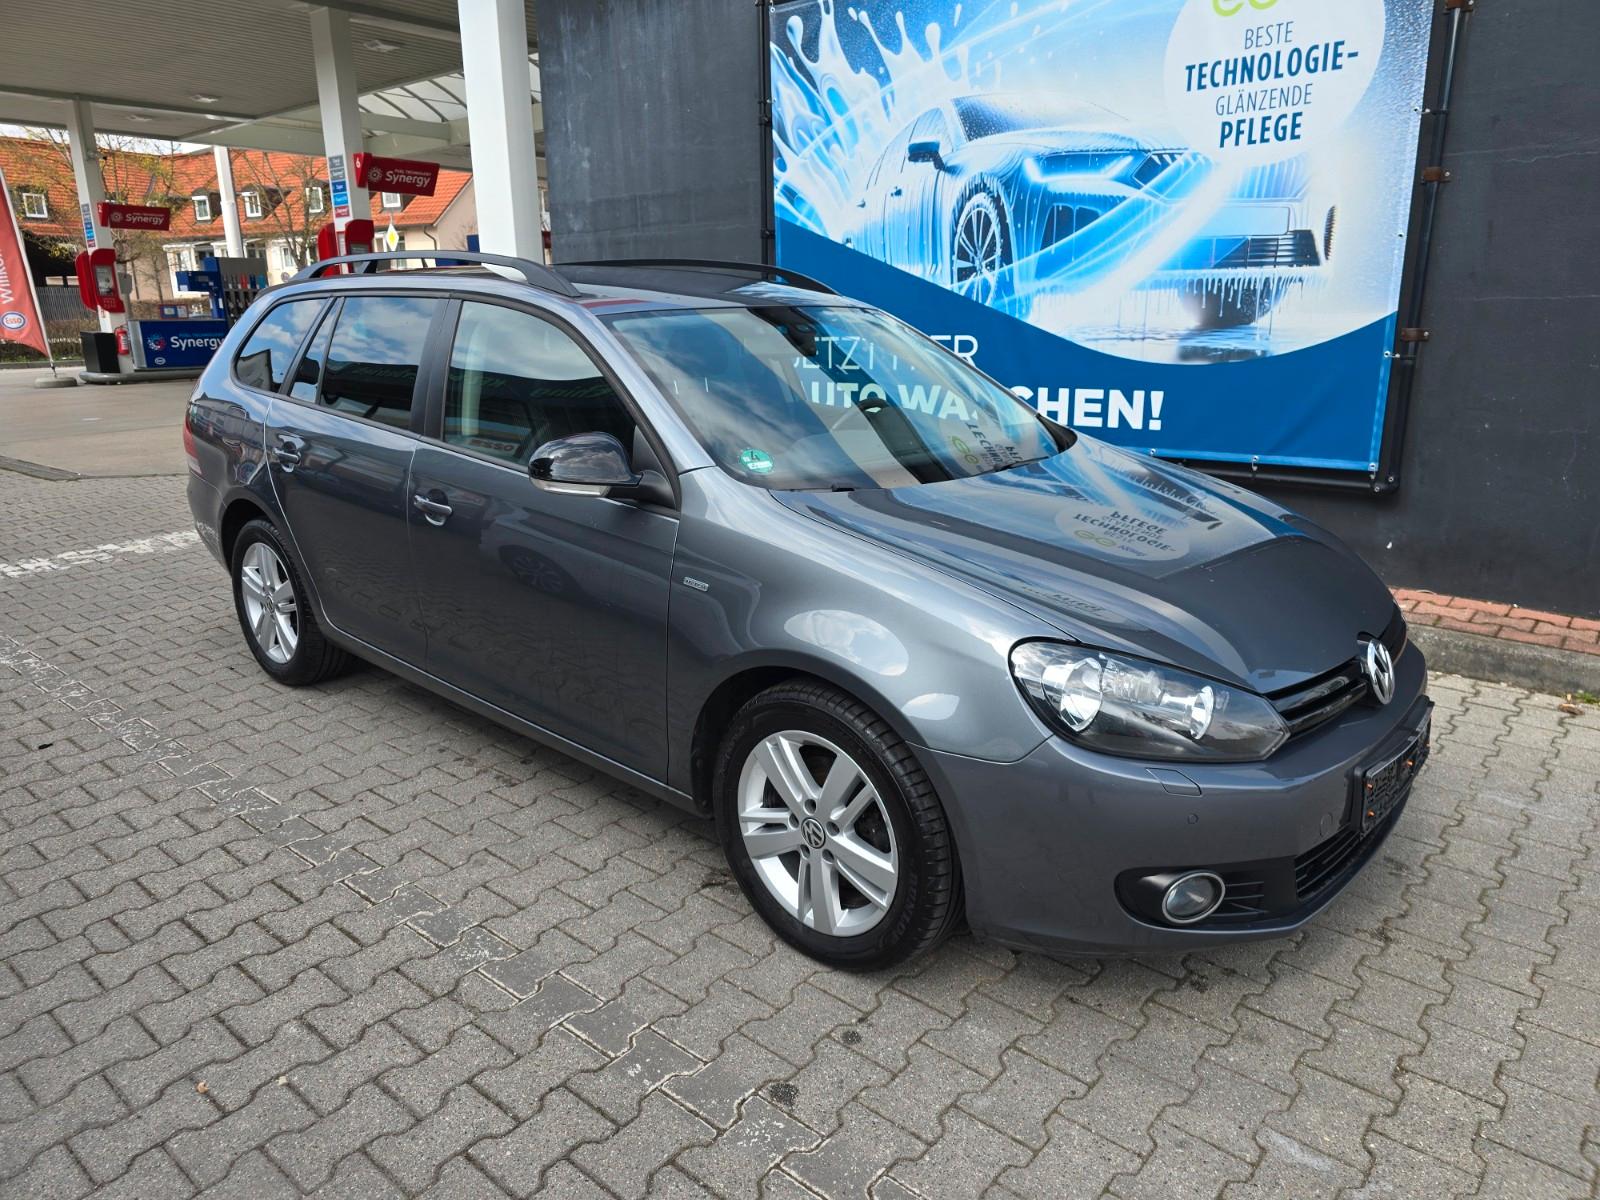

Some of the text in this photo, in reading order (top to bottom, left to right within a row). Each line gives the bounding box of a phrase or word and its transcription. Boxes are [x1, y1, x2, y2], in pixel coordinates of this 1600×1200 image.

[1243, 21, 1294, 49] BESTE
[1185, 40, 1359, 92] TECHNOLOGIE-
[1215, 83, 1313, 116] GLÄNZENDE
[1219, 111, 1303, 148] PFLEGE
[385, 170, 431, 188] Synergy
[125, 213, 164, 225] Synergy
[897, 384, 1164, 431] WAHEN!
